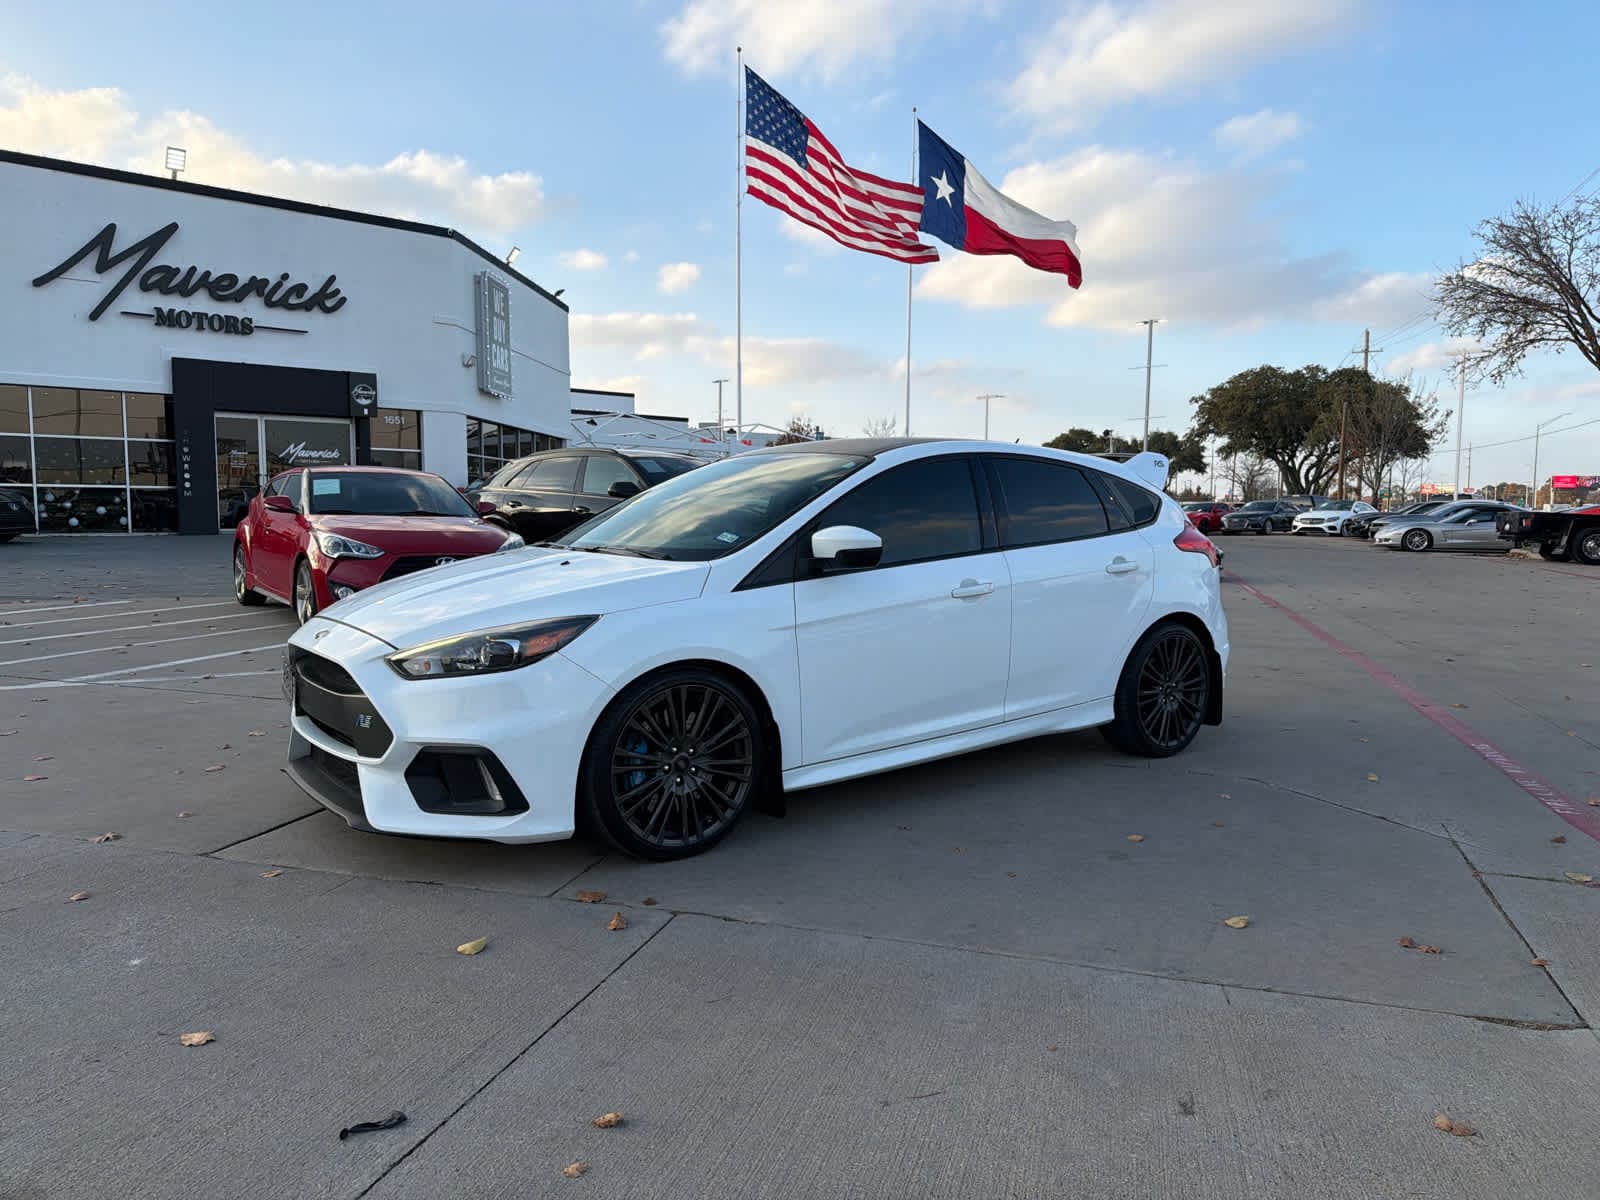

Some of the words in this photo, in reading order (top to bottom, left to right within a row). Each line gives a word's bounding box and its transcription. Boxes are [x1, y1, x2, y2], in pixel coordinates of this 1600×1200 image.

[32, 222, 347, 322] Maverick
[153, 306, 255, 335] MOTORS
[182, 429, 193, 497] HOWROOM
[279, 441, 341, 464] Maverick
